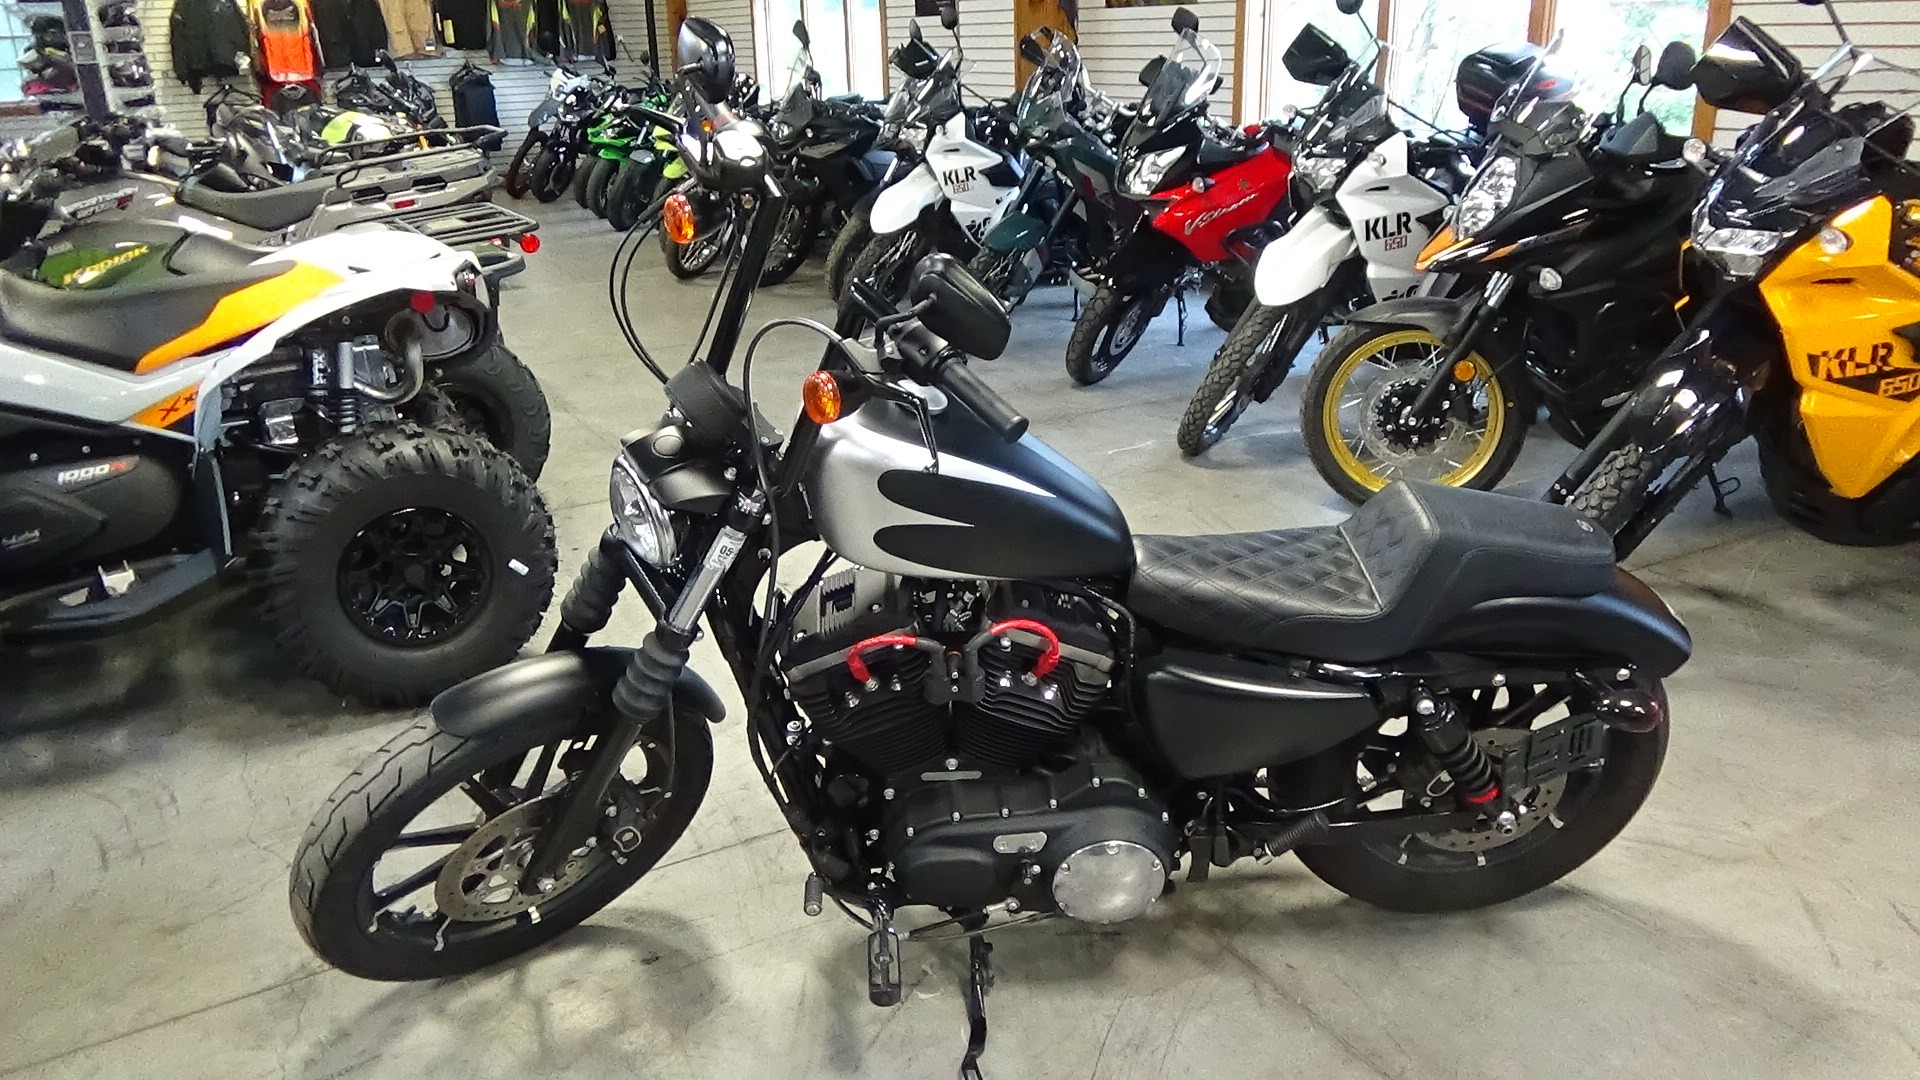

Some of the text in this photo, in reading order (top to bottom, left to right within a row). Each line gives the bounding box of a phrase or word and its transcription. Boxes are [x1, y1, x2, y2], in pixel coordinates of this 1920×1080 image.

[943, 166, 977, 186] KLR
[1365, 211, 1413, 242] KLR
[1384, 235, 1408, 252] 650
[1816, 342, 1896, 378] KLR
[1879, 374, 1920, 397] 650
